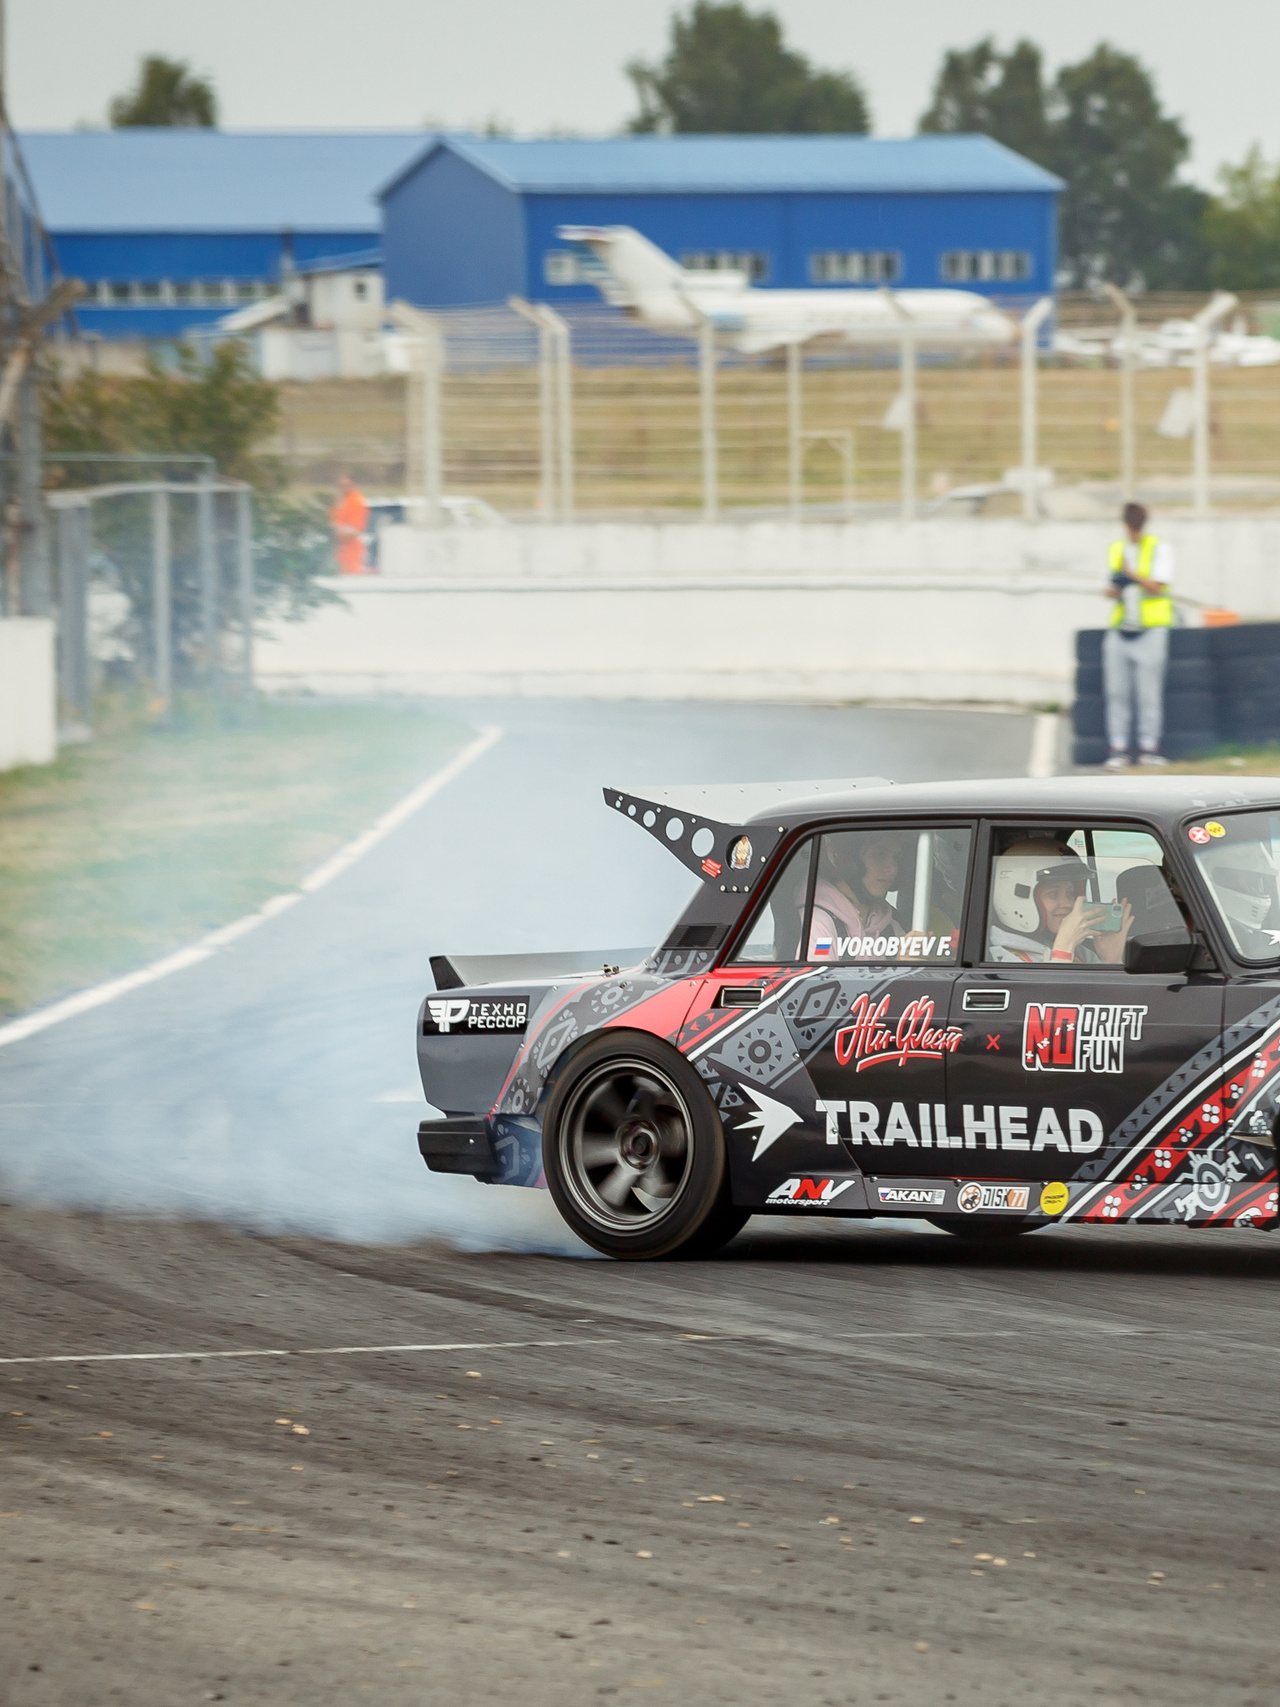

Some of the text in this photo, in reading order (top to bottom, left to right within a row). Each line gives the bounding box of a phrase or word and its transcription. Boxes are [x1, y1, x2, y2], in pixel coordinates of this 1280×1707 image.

[836, 936, 952, 957] VOROBYEV F.
[470, 1003, 527, 1016] ТЕХНО
[468, 1016, 526, 1029] РЕССОР
[1079, 1004, 1148, 1040] DRIFT
[1022, 1003, 1079, 1072] NO
[1079, 1037, 1124, 1073] FUN
[816, 1099, 1104, 1154] TRAILHEAD
[765, 1198, 831, 1206] motorsport
[885, 1190, 933, 1202] AKAN
